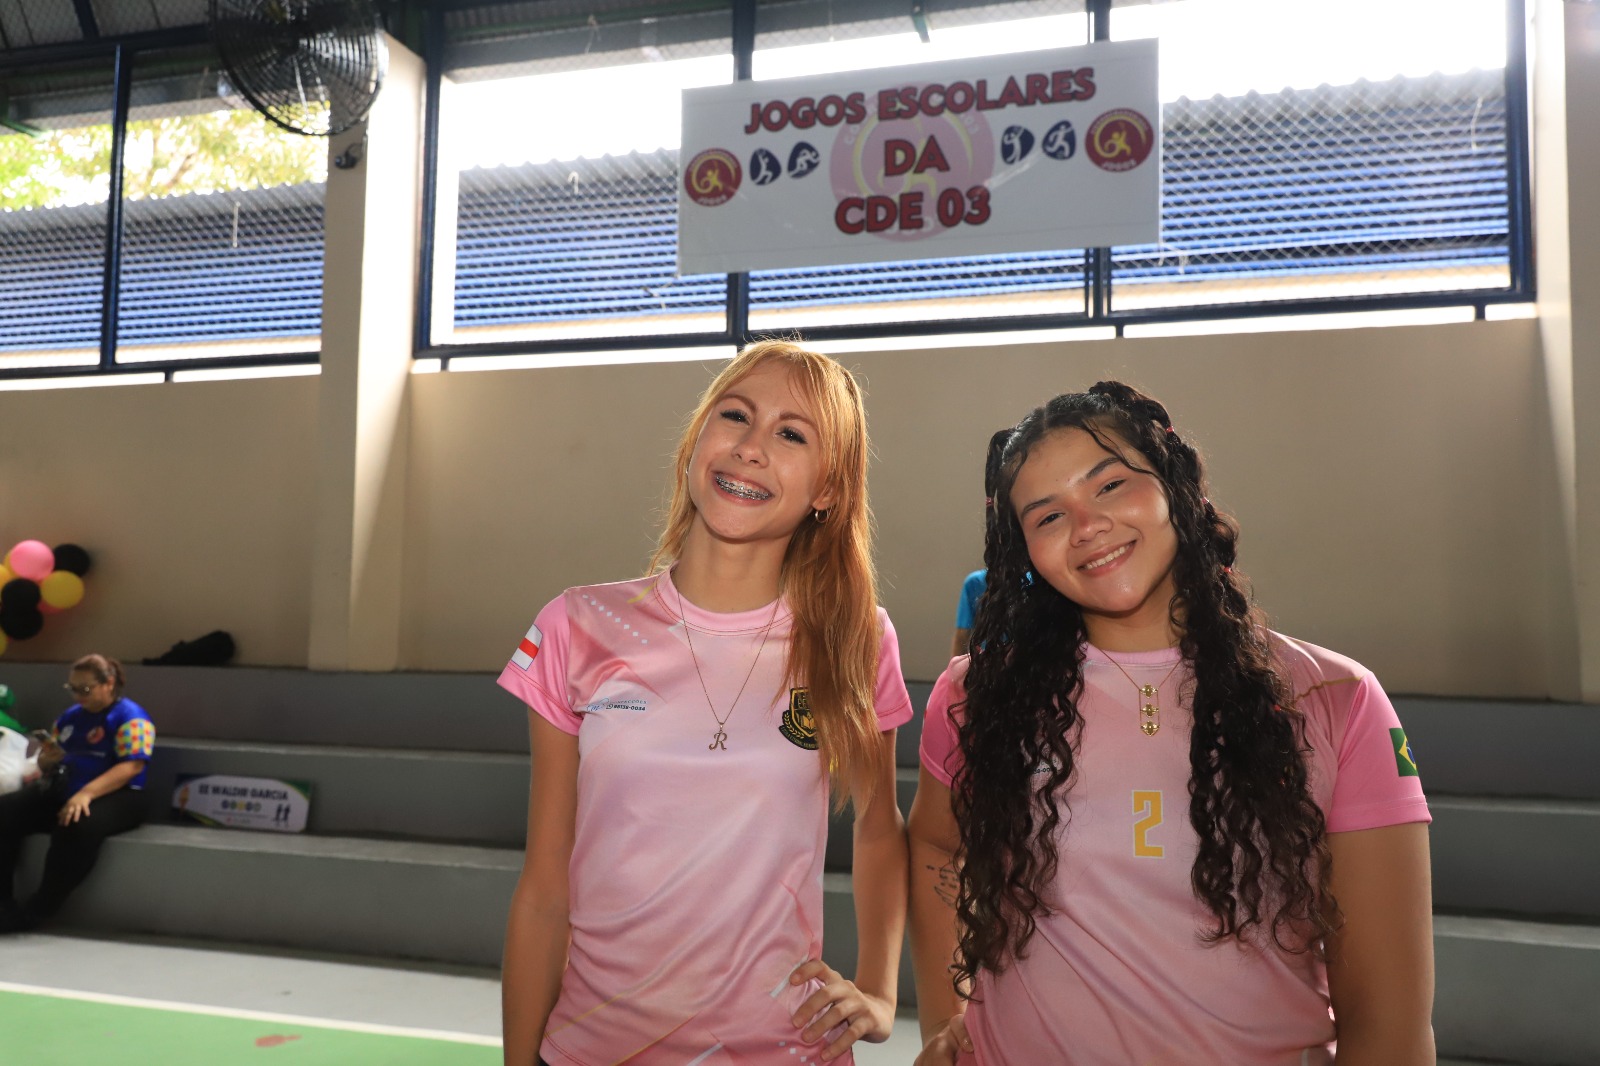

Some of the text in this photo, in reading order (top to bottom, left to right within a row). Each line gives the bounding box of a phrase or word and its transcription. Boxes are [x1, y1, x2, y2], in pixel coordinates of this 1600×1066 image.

[745, 92, 867, 135] JOGOS
[877, 67, 1097, 122] ESCOLARES
[884, 134, 950, 177] DA
[835, 191, 924, 235] CDE
[937, 185, 991, 228] 03
[708, 732, 728, 750] R
[1132, 789, 1165, 859] 2
